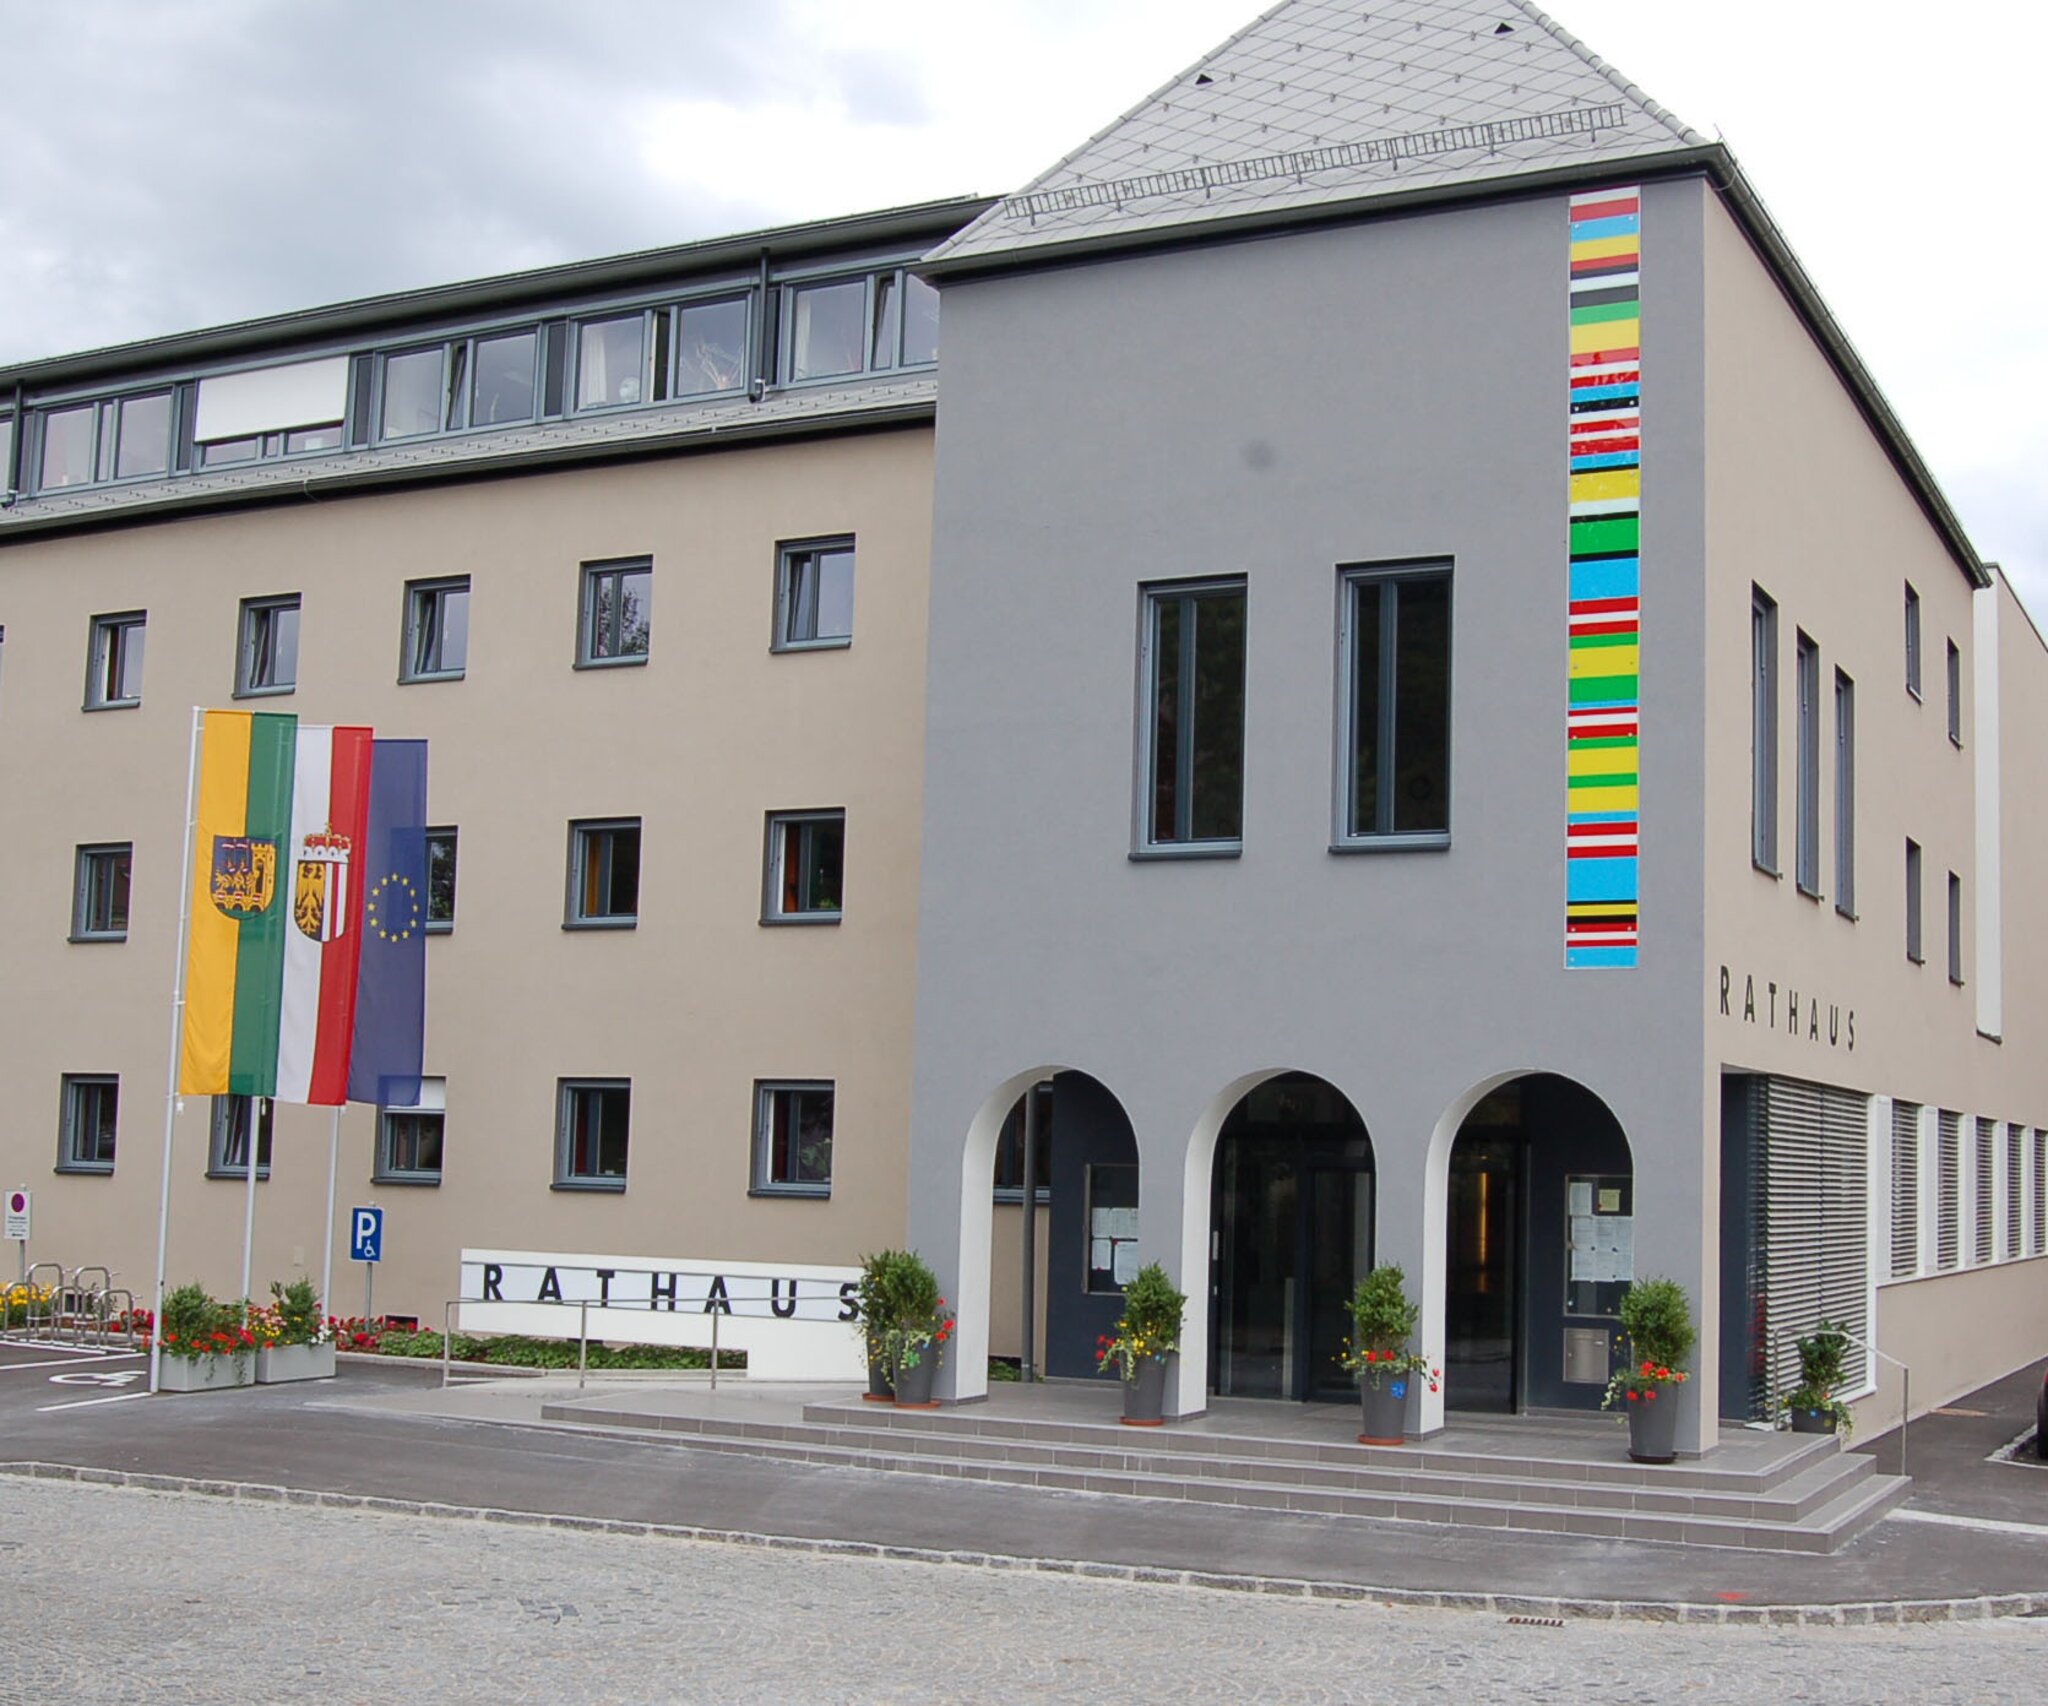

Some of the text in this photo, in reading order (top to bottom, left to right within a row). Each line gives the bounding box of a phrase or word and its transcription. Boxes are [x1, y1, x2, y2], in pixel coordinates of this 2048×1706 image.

[1719, 964, 1855, 1052] RATHAUS
[355, 1211, 377, 1250] P
[482, 1263, 860, 1322] RATHAUS
